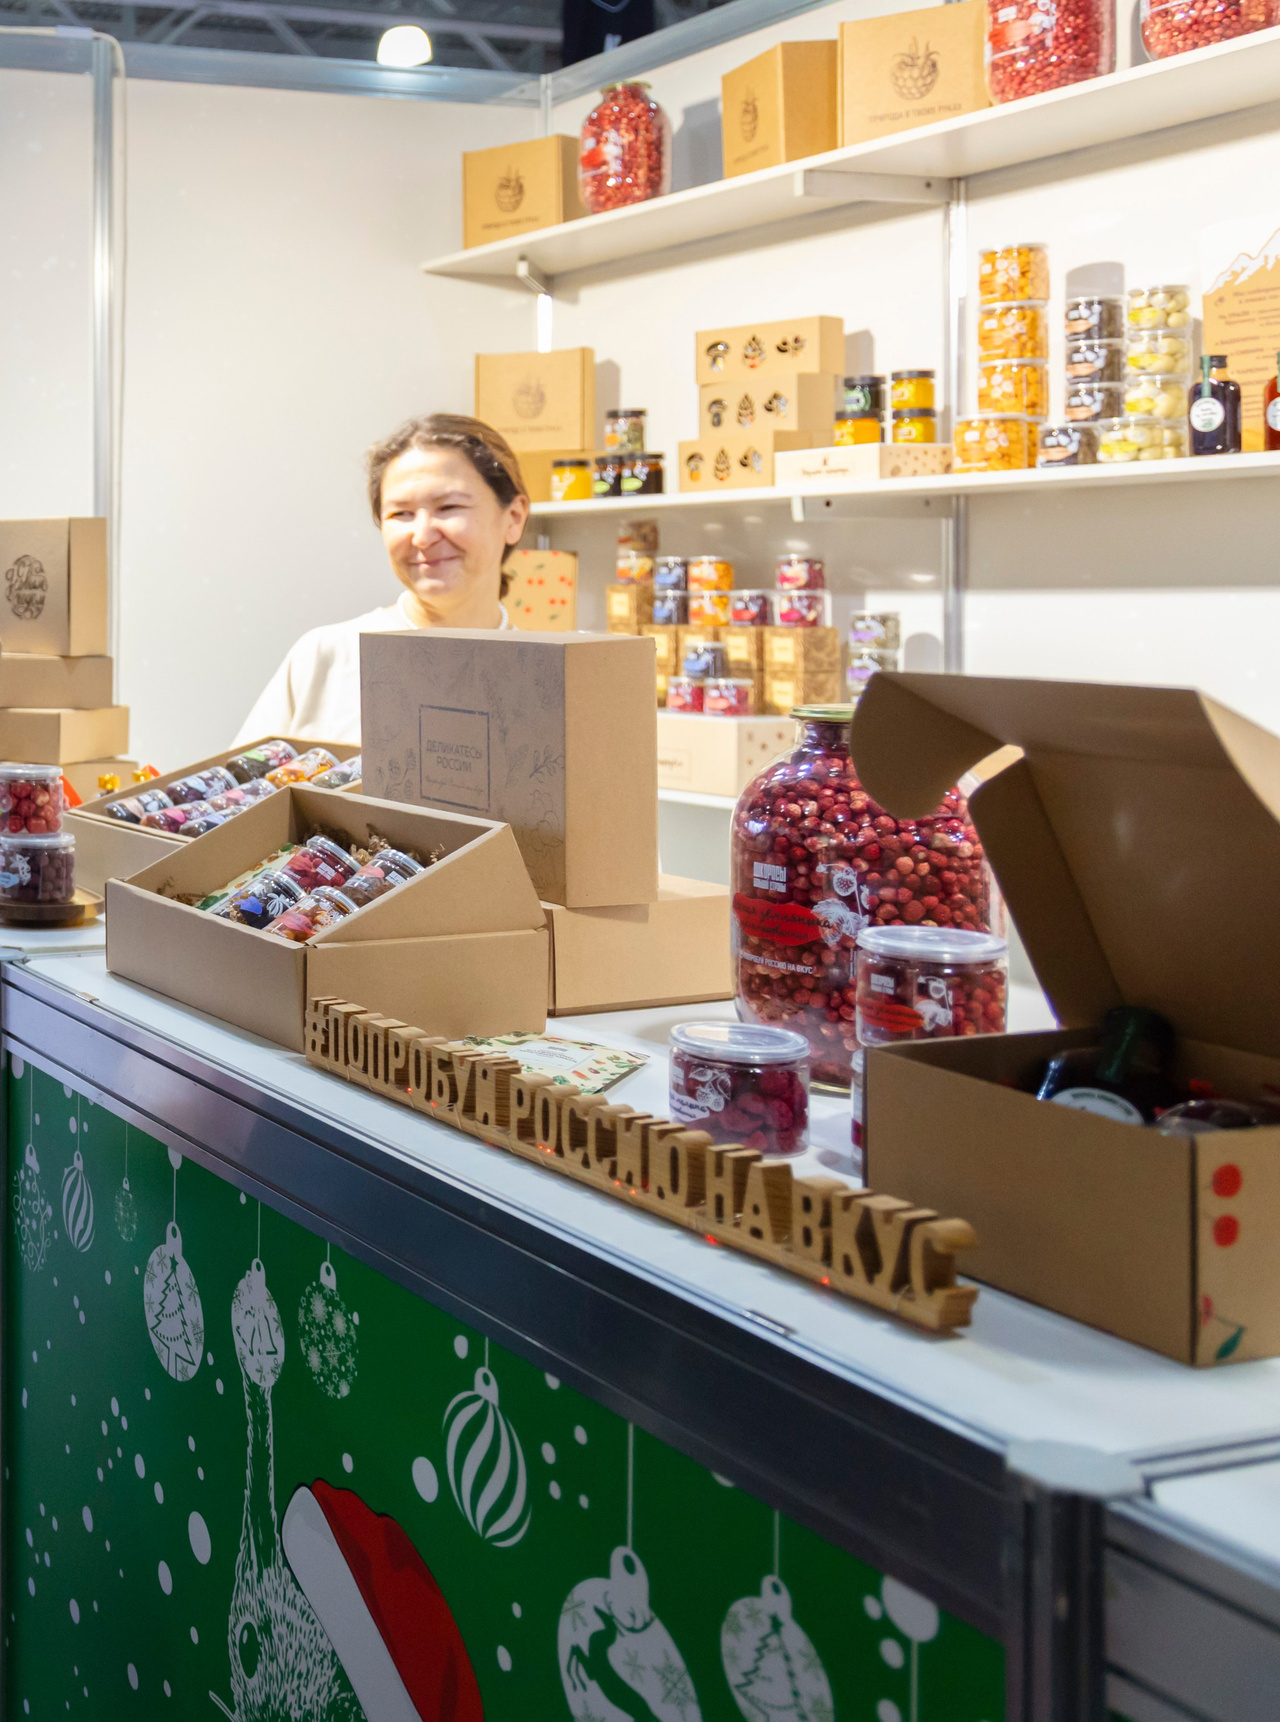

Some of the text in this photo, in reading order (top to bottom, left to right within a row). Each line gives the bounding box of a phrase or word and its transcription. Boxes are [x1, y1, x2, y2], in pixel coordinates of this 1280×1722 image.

[426, 740, 482, 760] ДЕЛИКАТЕСЫ
[437, 756, 472, 773] РОССИИ
[796, 963, 813, 975] ВКУС
[510, 1073, 704, 1208] РОССИЮ
[706, 1144, 791, 1246] НА
[793, 1178, 976, 1308] ВКУС
